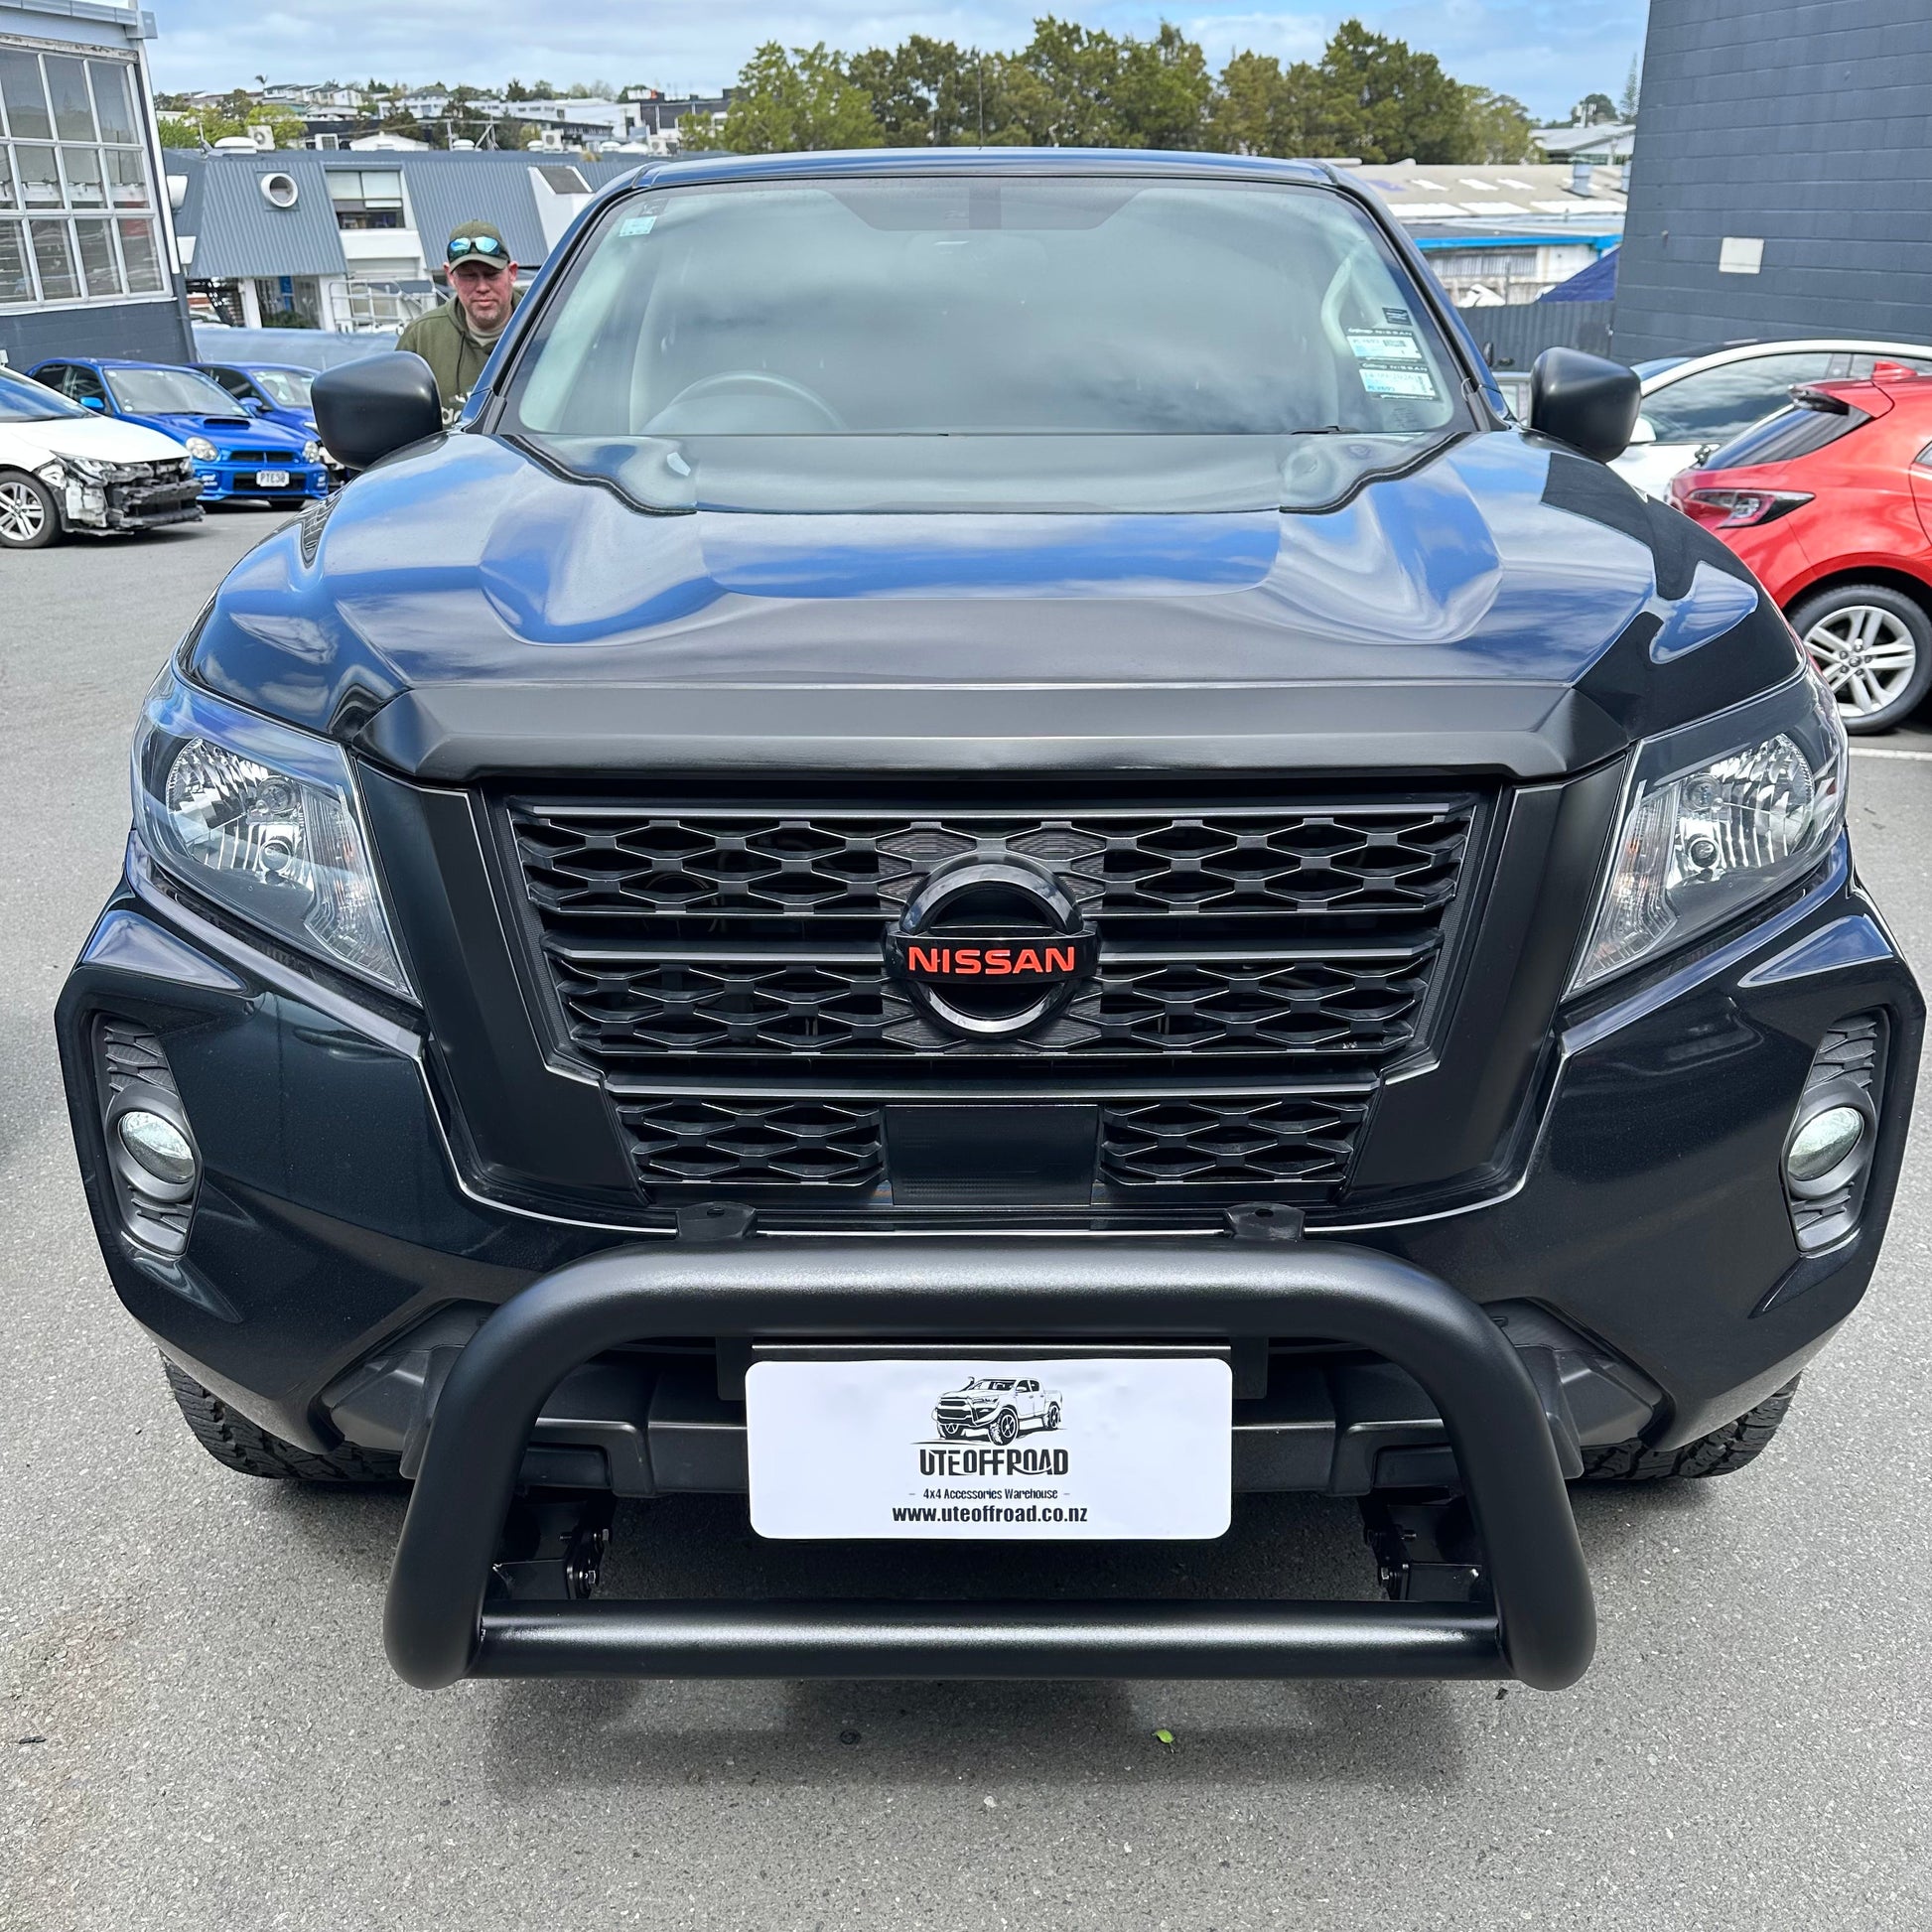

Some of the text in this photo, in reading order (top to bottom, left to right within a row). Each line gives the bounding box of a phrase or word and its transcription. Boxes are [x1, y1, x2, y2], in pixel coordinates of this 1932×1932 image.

[908, 946, 1075, 975] NISSAN
[922, 1488, 1058, 1499] 4x4 Accessories Warehouse
[893, 1505, 1088, 1522] www.uteoffroad.co.nz
